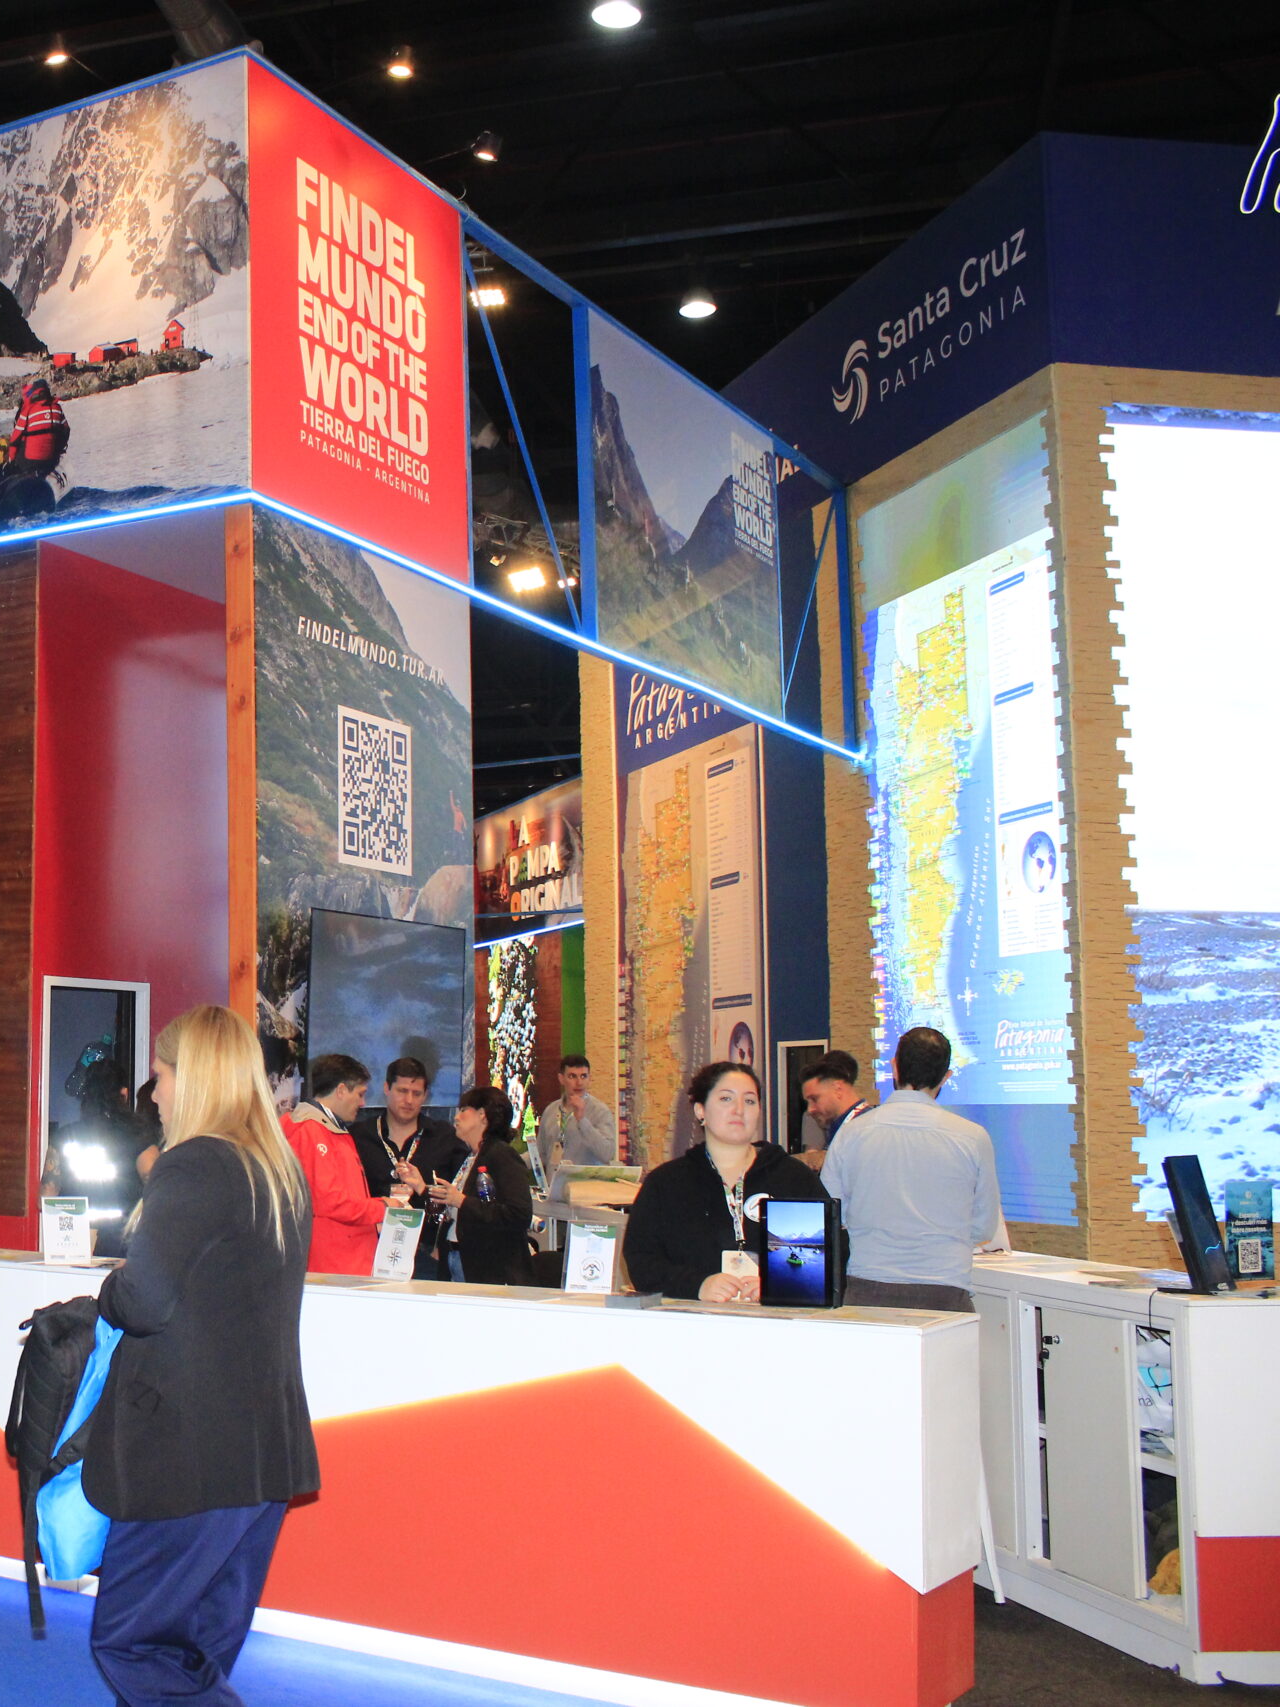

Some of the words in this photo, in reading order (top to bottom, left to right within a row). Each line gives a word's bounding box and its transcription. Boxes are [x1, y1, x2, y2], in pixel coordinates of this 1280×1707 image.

[298, 223, 427, 353] MUNDO
[298, 286, 348, 353] END
[351, 321, 381, 370] OF
[383, 337, 428, 401] THE
[877, 286, 951, 359] Santa
[959, 228, 1027, 298] Cruz
[879, 285, 1026, 402] PATAGONIA
[299, 335, 429, 457] WORLD
[299, 400, 356, 449] TIERRA
[358, 430, 385, 463] DEL
[387, 445, 430, 485] FUEGO
[300, 430, 362, 471] PATAGONIA
[374, 467, 431, 505] ARGENTINA
[733, 502, 773, 547] WORLD
[634, 702, 721, 750] ARGENTIN
